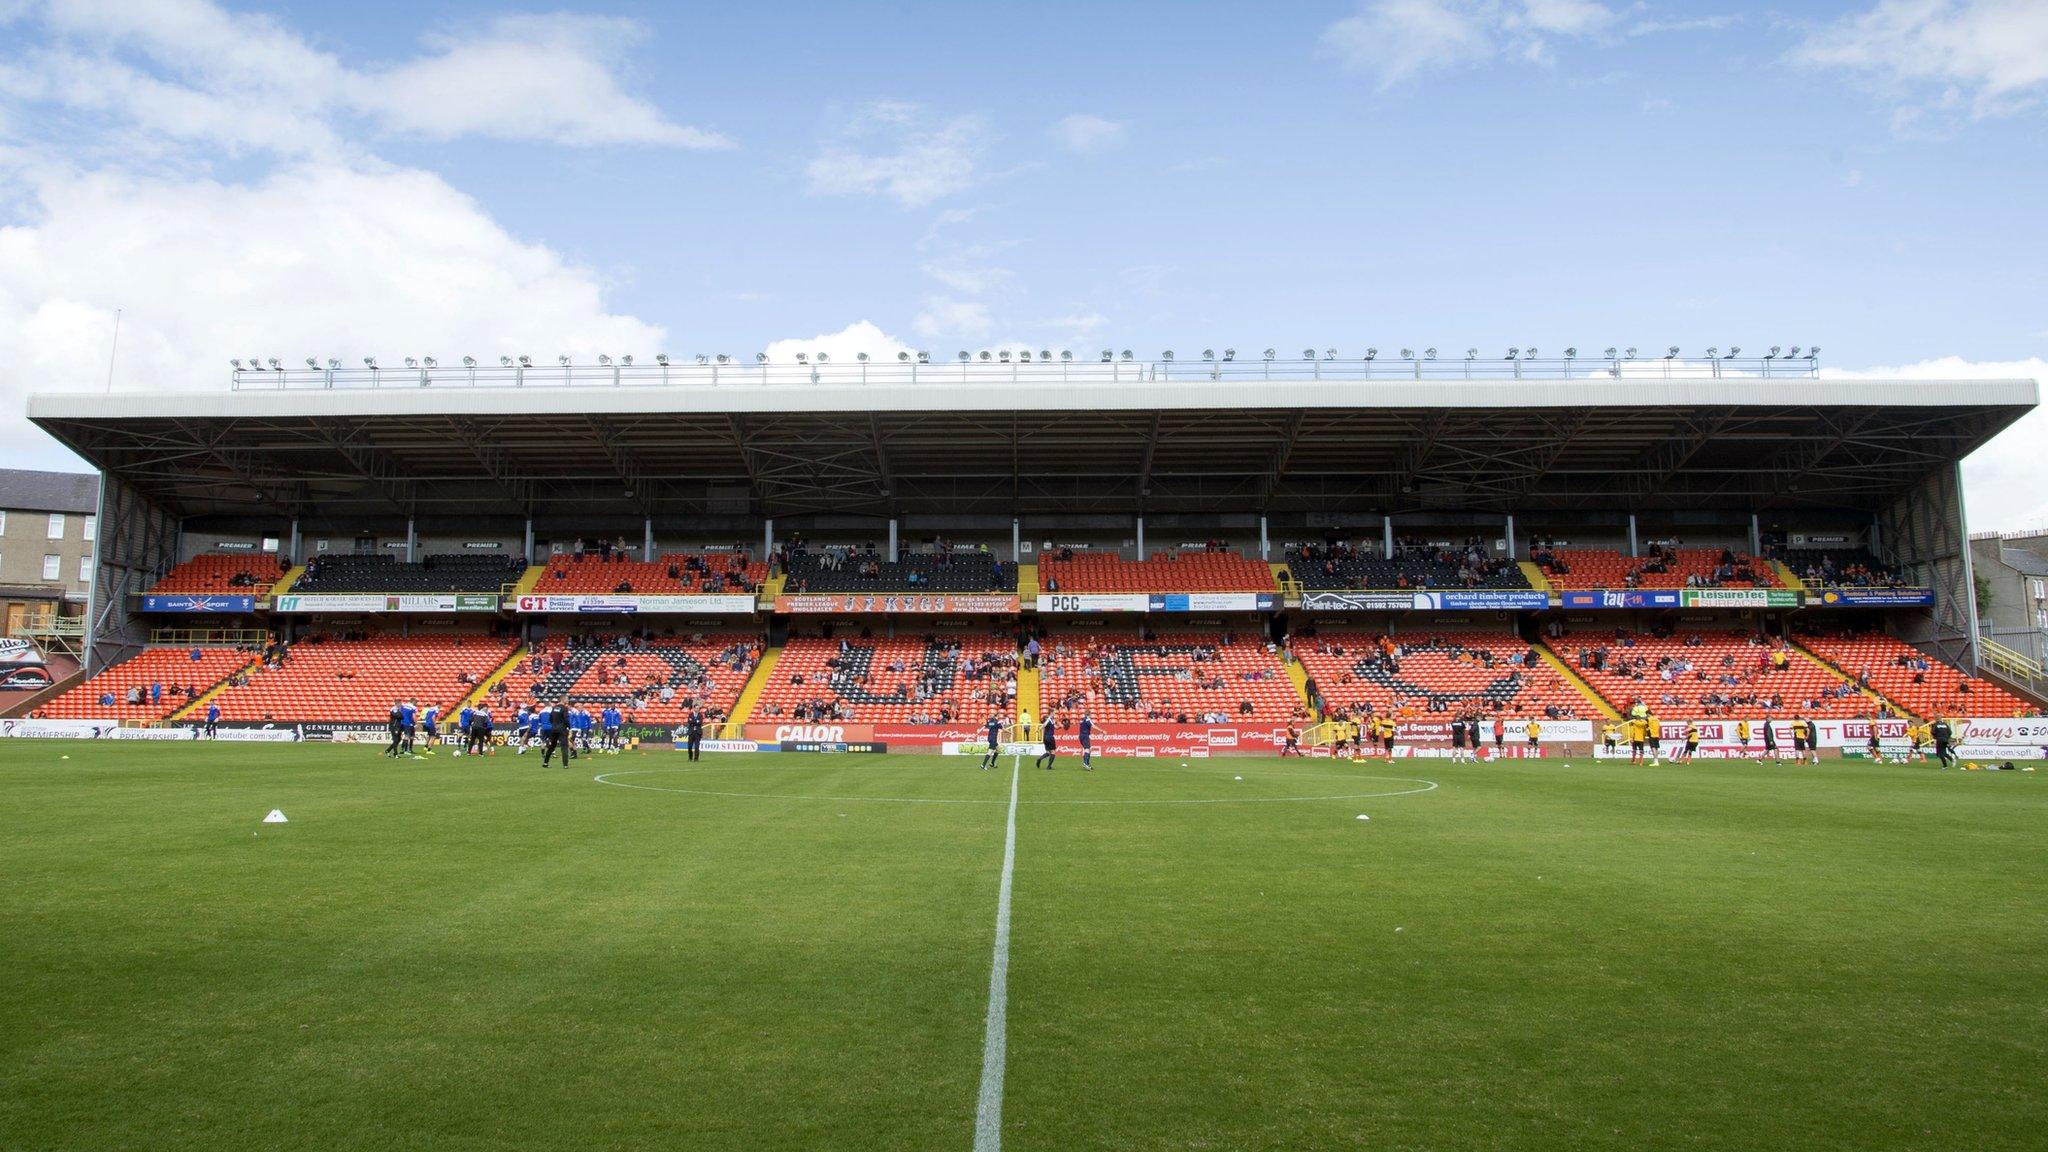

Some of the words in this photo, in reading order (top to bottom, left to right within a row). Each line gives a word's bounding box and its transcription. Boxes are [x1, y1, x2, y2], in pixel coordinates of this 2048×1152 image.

[218, 541, 253, 549] PREMIER
[466, 541, 500, 549] PREMIER
[1479, 592, 1507, 600] timber
[1509, 592, 1545, 602] products
[1701, 591, 1764, 599] LeisureTec
[402, 597, 438, 605] MILLARS
[1052, 597, 1079, 610] PCC
[1410, 723, 1443, 734] Garage
[1662, 726, 1687, 738] FIFE
[1847, 724, 1870, 736] FIFE
[1957, 719, 2013, 743] Tonys
[776, 726, 844, 742] CALOR
[1139, 733, 1161, 741] powered
[1162, 733, 1171, 741] by
[1701, 749, 1726, 758] Daily
[1960, 748, 2032, 757] youtube.com/spfl
